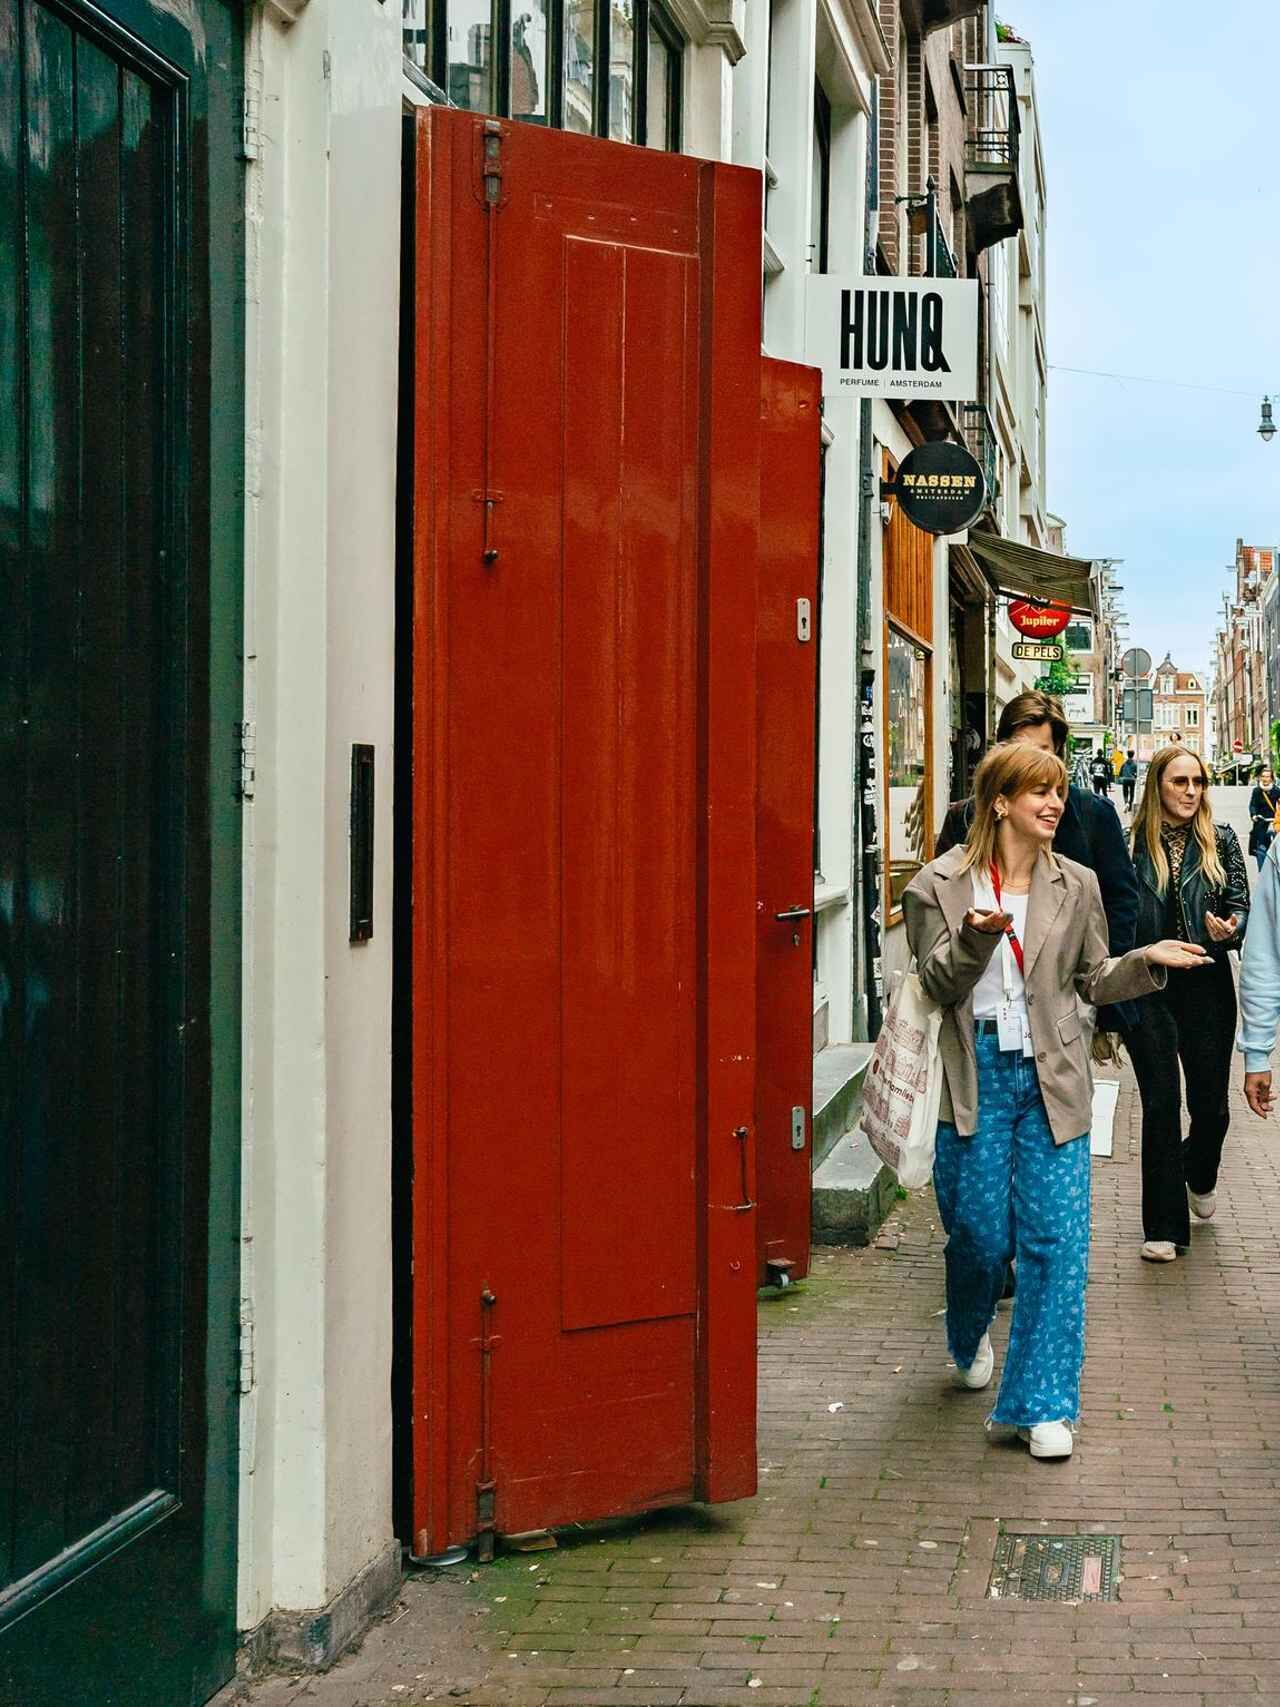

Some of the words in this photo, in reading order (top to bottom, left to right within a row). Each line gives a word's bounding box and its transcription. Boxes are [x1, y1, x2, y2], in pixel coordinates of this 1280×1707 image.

[840, 289, 952, 373] HUNQ
[839, 378, 881, 387] PERFUME
[890, 379, 943, 389] AMSTERDAM
[902, 474, 977, 488] NASSEN
[1020, 615, 1060, 628] Jupiler
[1033, 646, 1060, 658] PELS
